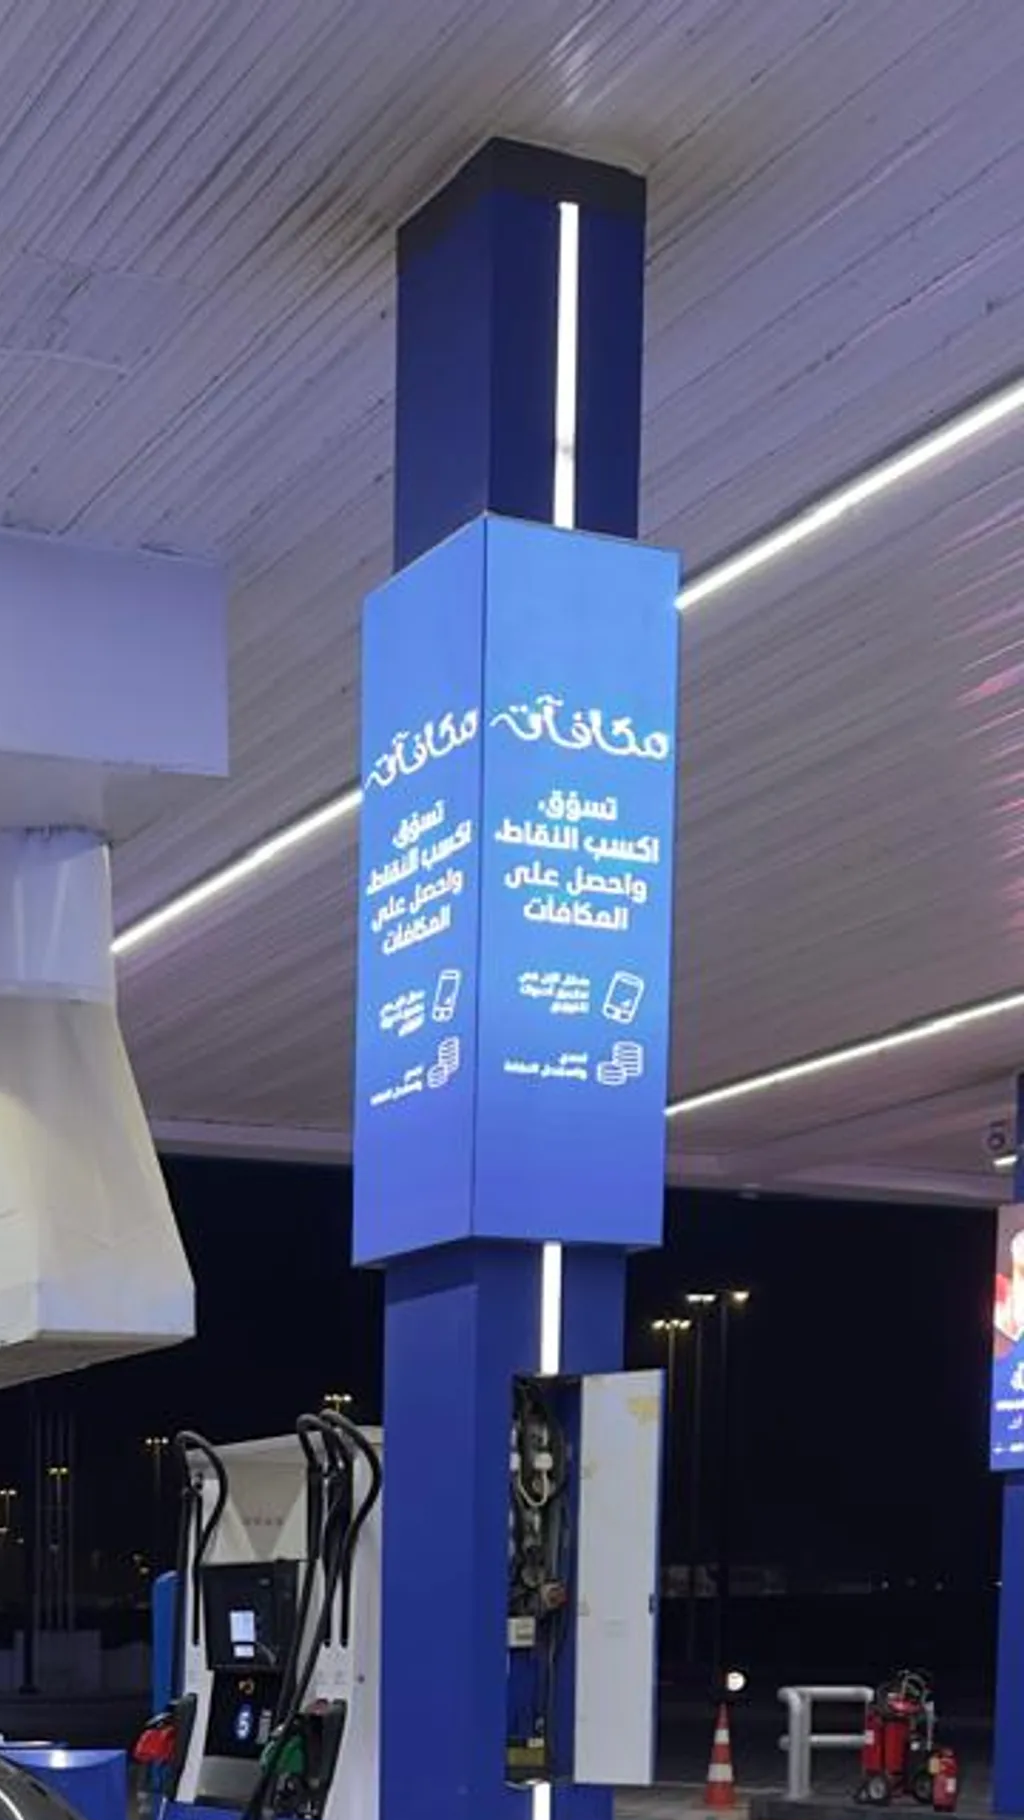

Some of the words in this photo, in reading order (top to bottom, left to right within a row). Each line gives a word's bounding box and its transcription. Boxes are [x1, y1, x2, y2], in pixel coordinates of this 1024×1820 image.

[489, 693, 669, 760] مكافآت
[583, 835, 660, 865] اكسب
[504, 860, 560, 889] على
[566, 866, 649, 904] واحصل
